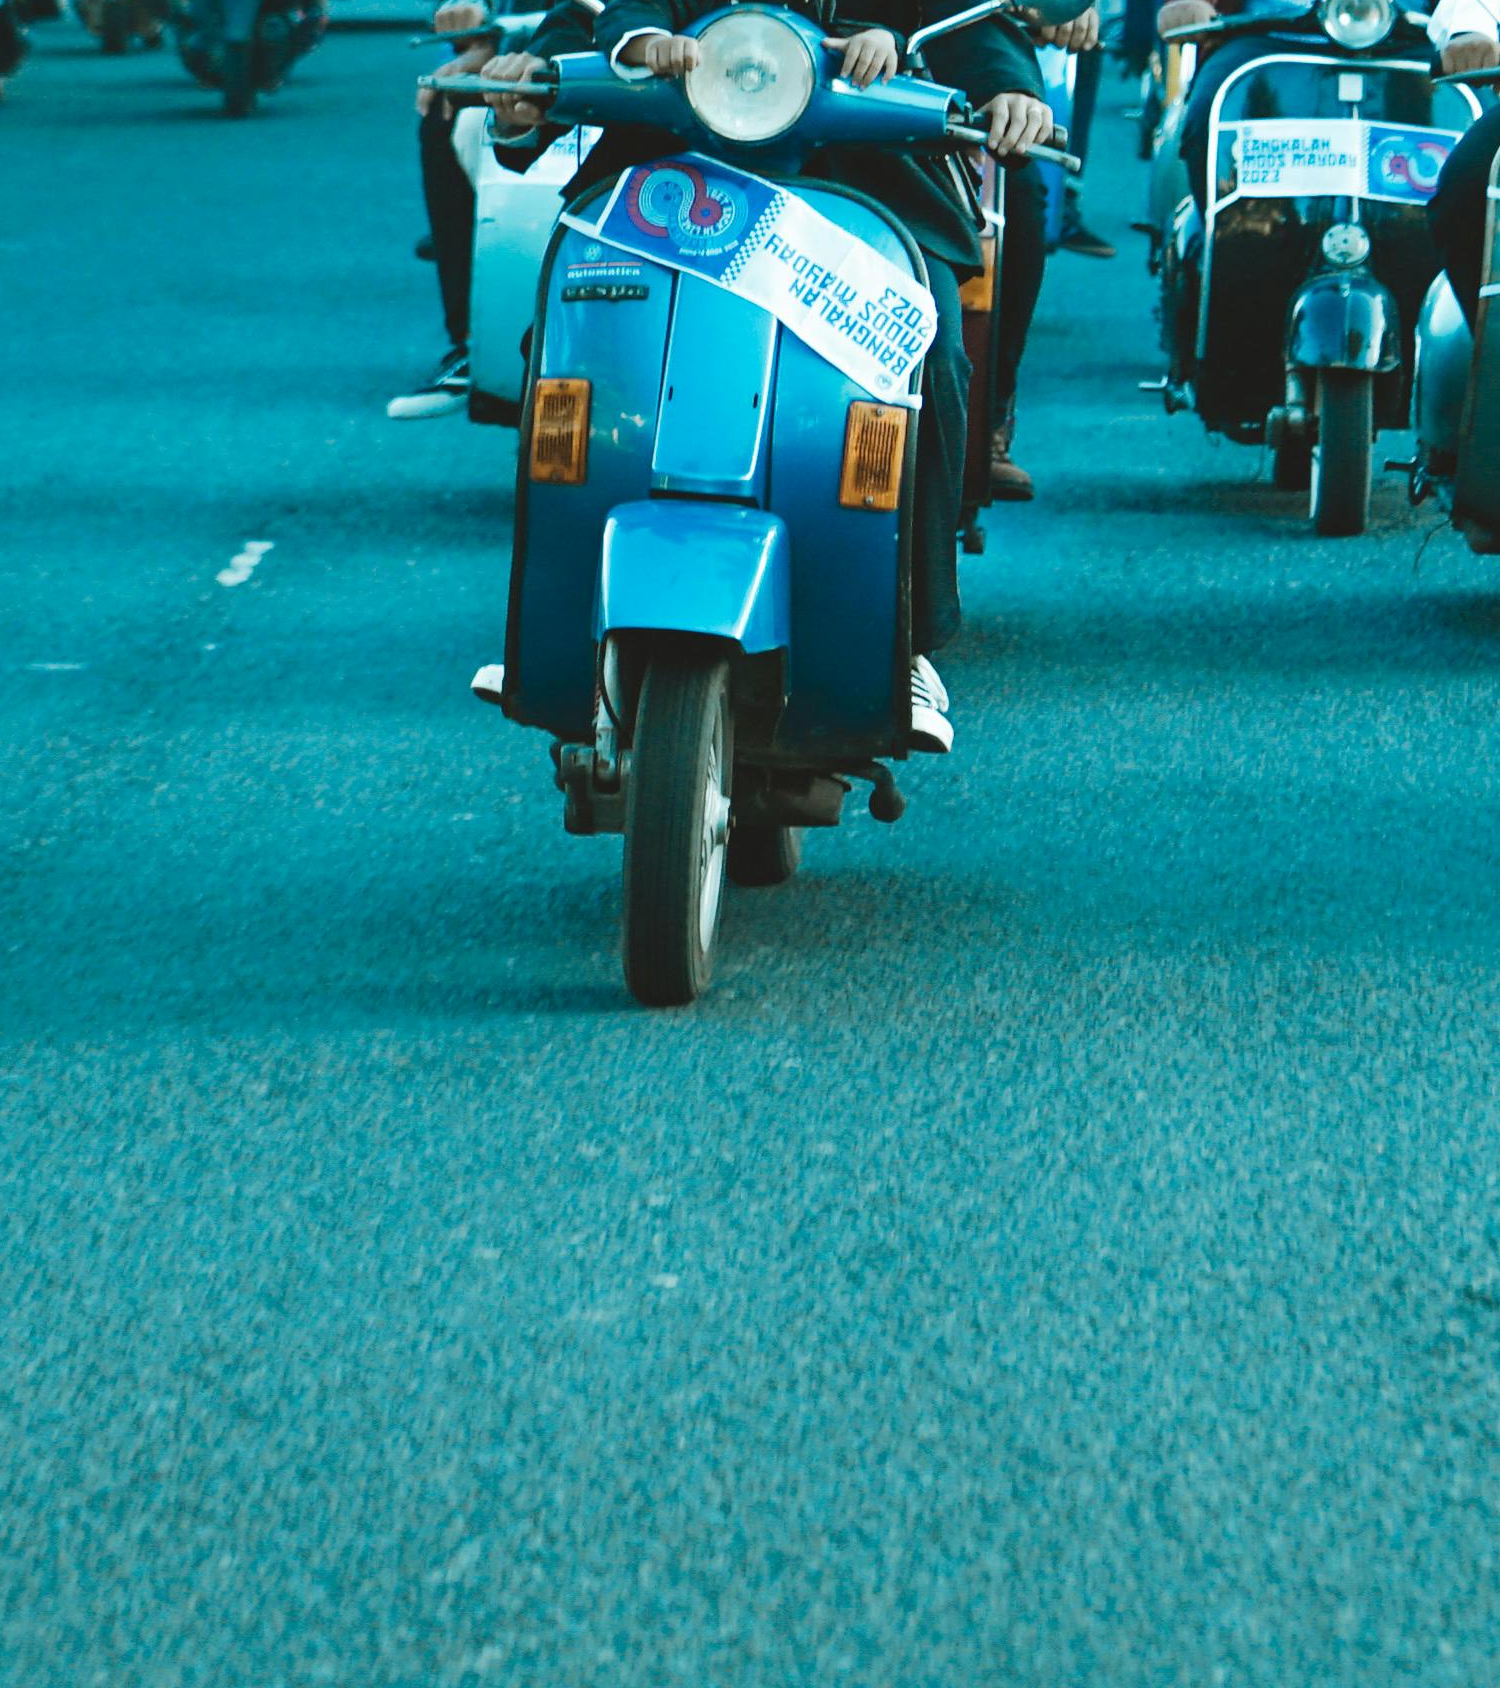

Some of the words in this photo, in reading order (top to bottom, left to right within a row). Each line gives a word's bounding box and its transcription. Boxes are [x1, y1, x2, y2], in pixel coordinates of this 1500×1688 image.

[1242, 138, 1331, 154] BANGKALAN
[1242, 153, 1286, 168] MODS
[763, 233, 858, 309] MAYDAY
[788, 277, 909, 377] BANGKALAN
[858, 299, 923, 359] MODS
[878, 287, 933, 339] 2023
